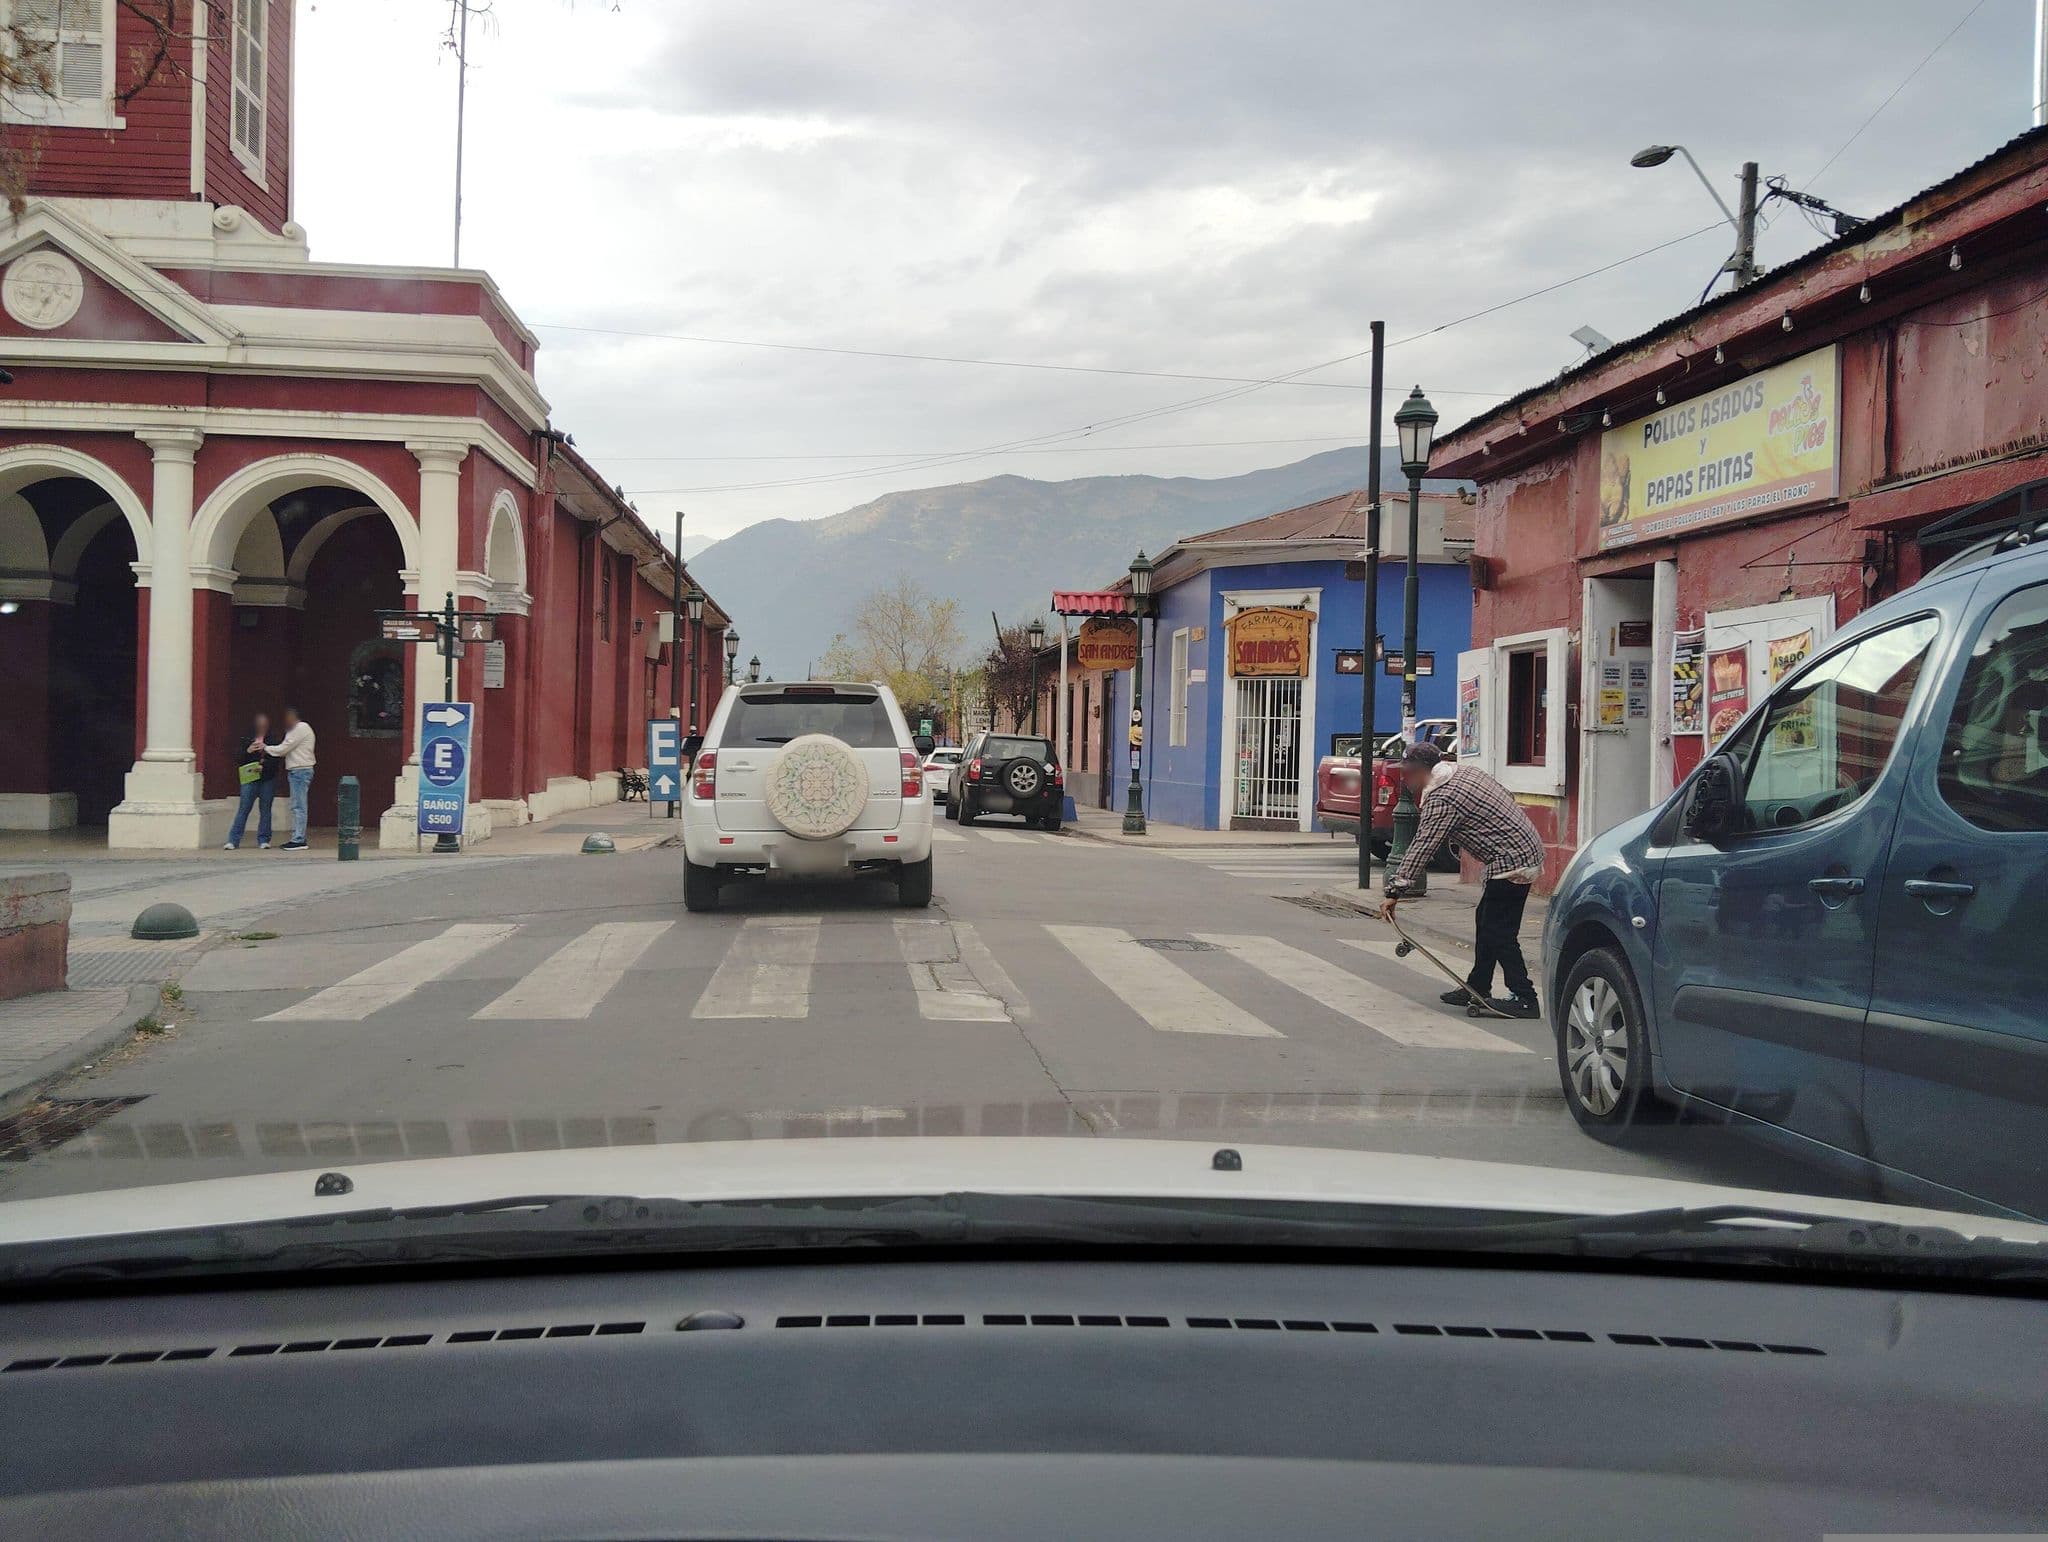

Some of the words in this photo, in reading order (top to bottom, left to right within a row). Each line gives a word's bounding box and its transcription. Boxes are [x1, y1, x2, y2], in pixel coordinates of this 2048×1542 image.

[1644, 406, 1696, 449] POLLOS
[1700, 380, 1764, 430] ASADOS
[1646, 470, 1694, 508] PAPAS
[1698, 451, 1754, 493] FRITAS
[1747, 493, 1771, 509] PAPAS
[1771, 488, 1781, 504] EL
[1240, 614, 1295, 633] FARMACIA
[1080, 643, 1099, 659] SAN
[1101, 643, 1137, 660] ANDRE
[1236, 640, 1258, 664] SAN
[1773, 650, 1805, 669] ASADO
[1780, 716, 1812, 731] FRITAS
[652, 723, 677, 765] E
[434, 743, 453, 769] E
[423, 798, 459, 811] BAÑOS
[427, 814, 453, 825] $500
